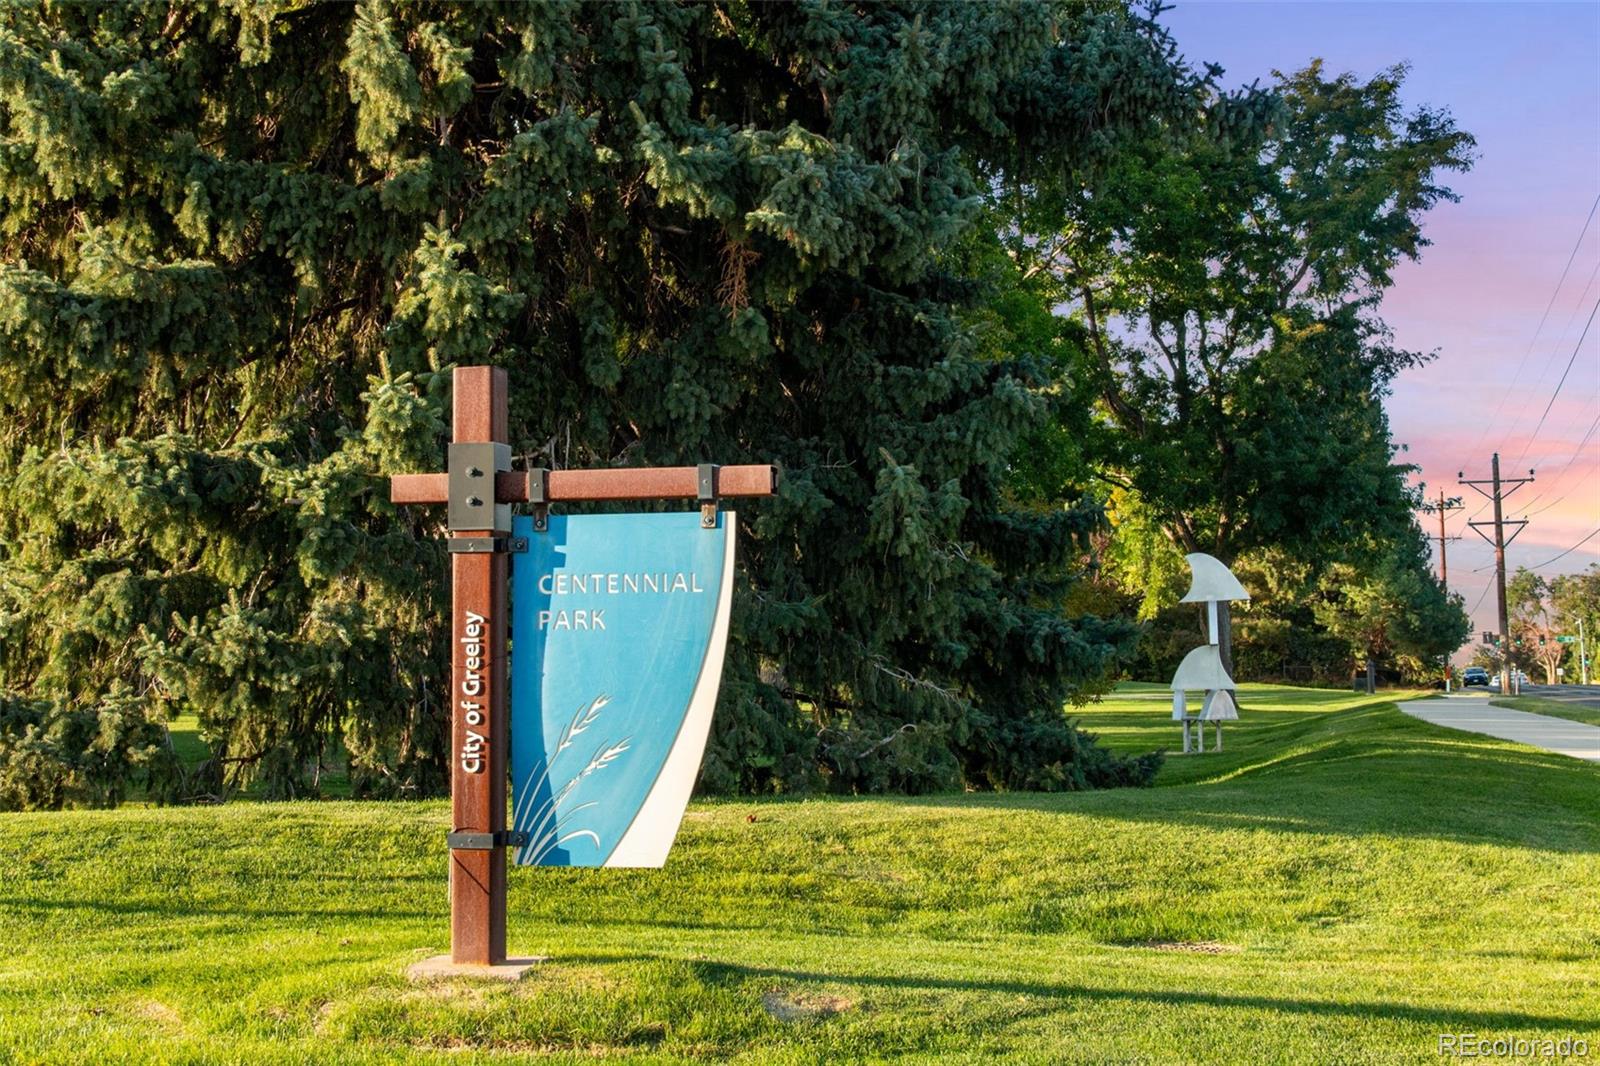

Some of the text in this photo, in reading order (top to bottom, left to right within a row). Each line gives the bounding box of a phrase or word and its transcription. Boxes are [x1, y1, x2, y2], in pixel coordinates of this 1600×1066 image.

[538, 573, 704, 596] CENTENNIAL
[538, 609, 607, 631] PARK
[461, 611, 485, 774] City of Greeley
